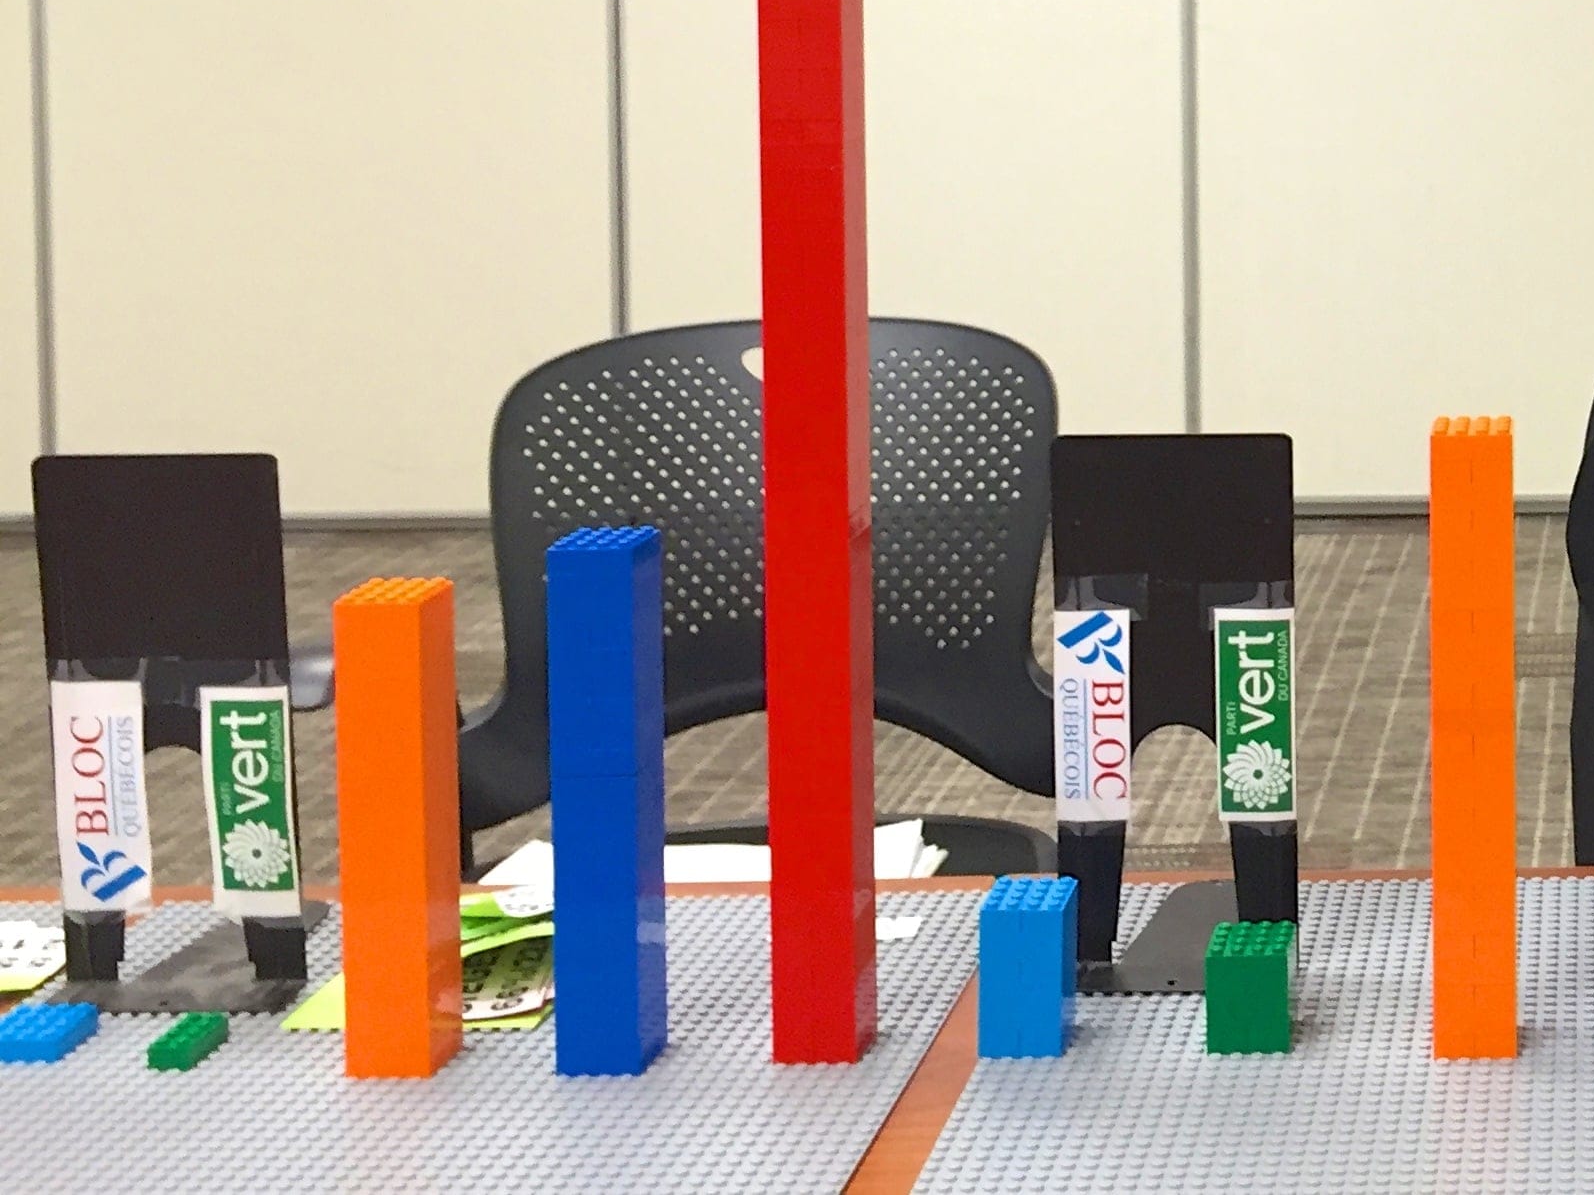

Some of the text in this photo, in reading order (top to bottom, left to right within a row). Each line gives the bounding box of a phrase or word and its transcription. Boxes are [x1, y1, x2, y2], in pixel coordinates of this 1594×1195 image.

[1227, 629, 1276, 734] vert
[1277, 629, 1288, 701] DU CANADA
[219, 710, 270, 815] vert
[1059, 678, 1083, 800] QUÉBÉCOIS
[1091, 680, 1128, 800] BLOC
[1225, 701, 1236, 735] PARTI
[70, 715, 109, 837] BLOC
